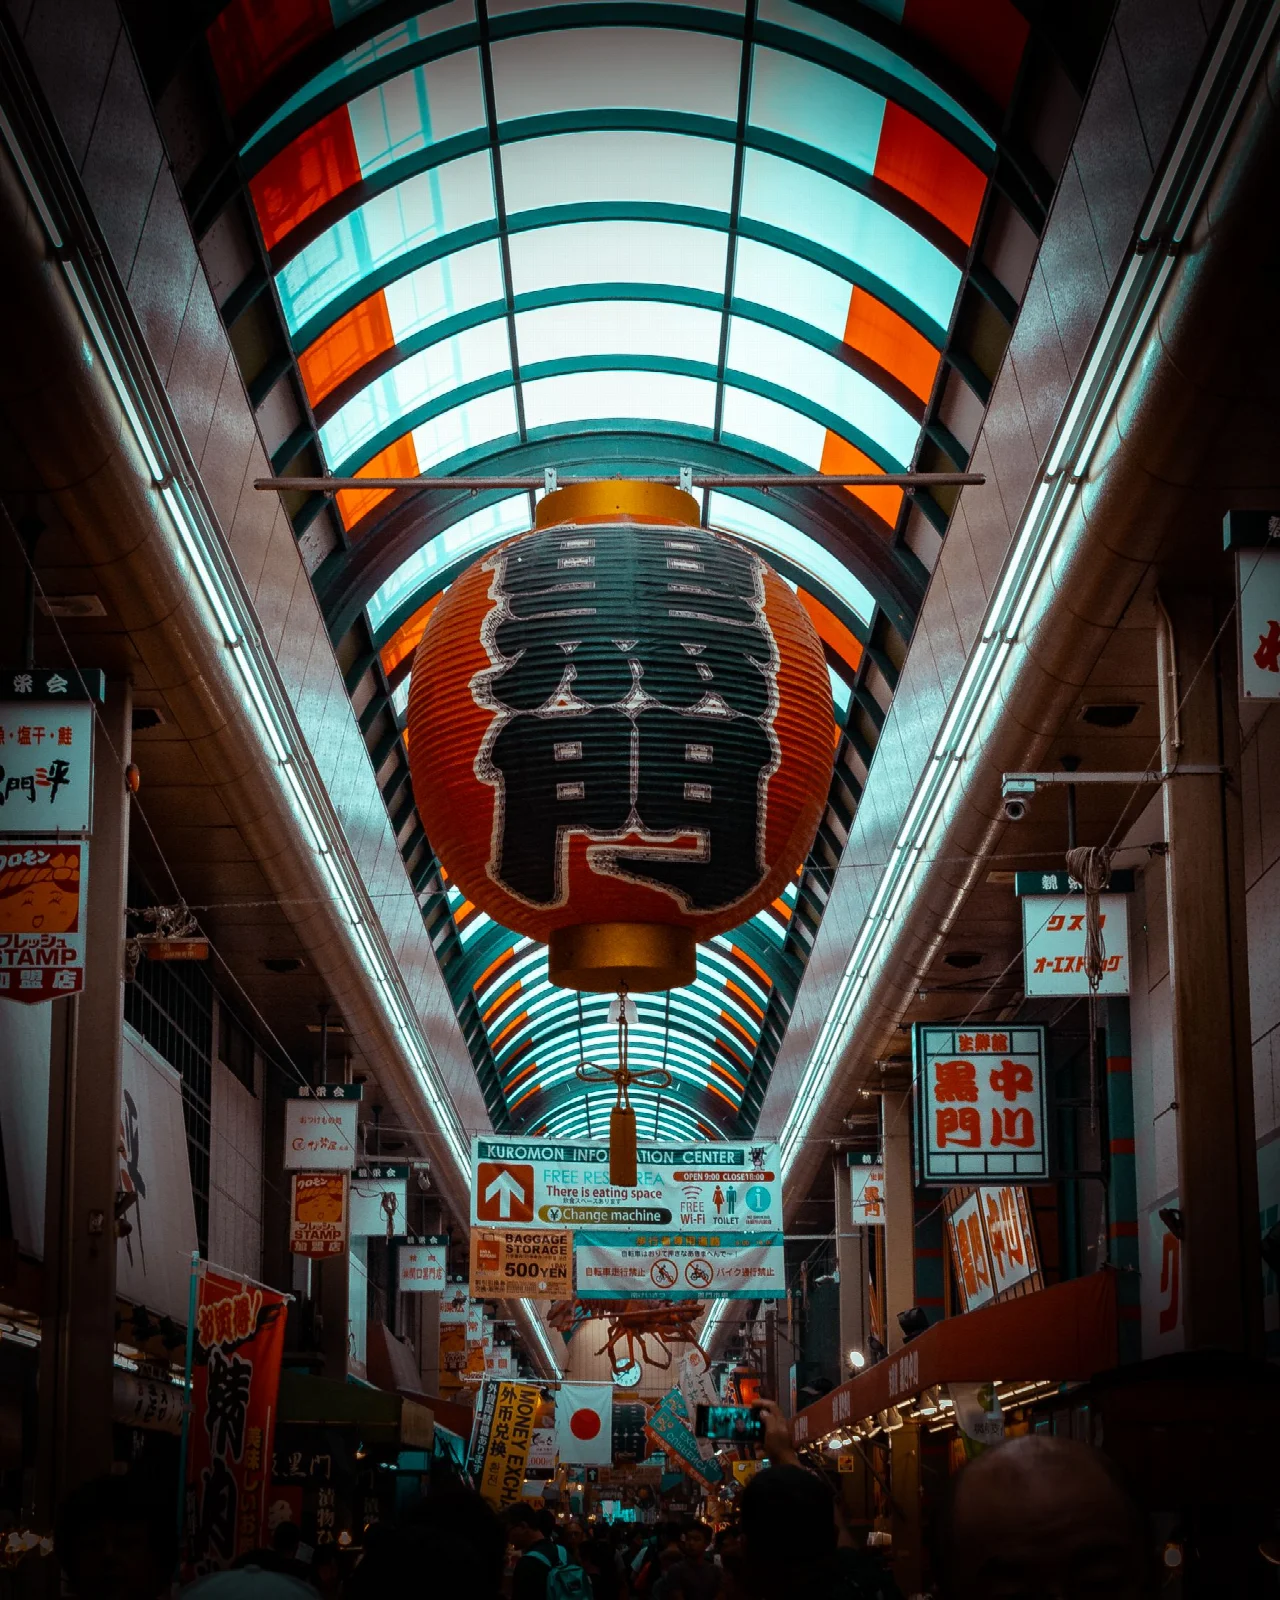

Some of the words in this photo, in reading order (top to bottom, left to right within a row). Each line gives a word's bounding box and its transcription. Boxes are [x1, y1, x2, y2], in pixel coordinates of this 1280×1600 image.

[0, 948, 77, 966] TAMP
[487, 1145, 564, 1161] KUROMON
[573, 1148, 674, 1164] INFOTION
[682, 1150, 736, 1164] CENTER
[543, 1169, 579, 1184] FREE
[584, 1170, 610, 1185] RES
[636, 1171, 665, 1186] REA
[683, 1172, 704, 1181] OPEN
[704, 1172, 720, 1181] 9:00
[546, 1185, 578, 1197] There
[581, 1186, 590, 1197] is
[592, 1186, 628, 1201] eating
[631, 1189, 663, 1202] space
[680, 1201, 705, 1212] FREE
[562, 1208, 609, 1223] Change
[610, 1208, 661, 1222] machine
[680, 1213, 706, 1225] Wi-Fi
[712, 1216, 740, 1225] TOILET
[294, 1230, 342, 1240] STAMP
[505, 1233, 568, 1245] BAGGAGE
[505, 1244, 568, 1255] STORAGE
[585, 1267, 646, 1277] 自転車走行禁止
[511, 1389, 537, 1451] MONEY
